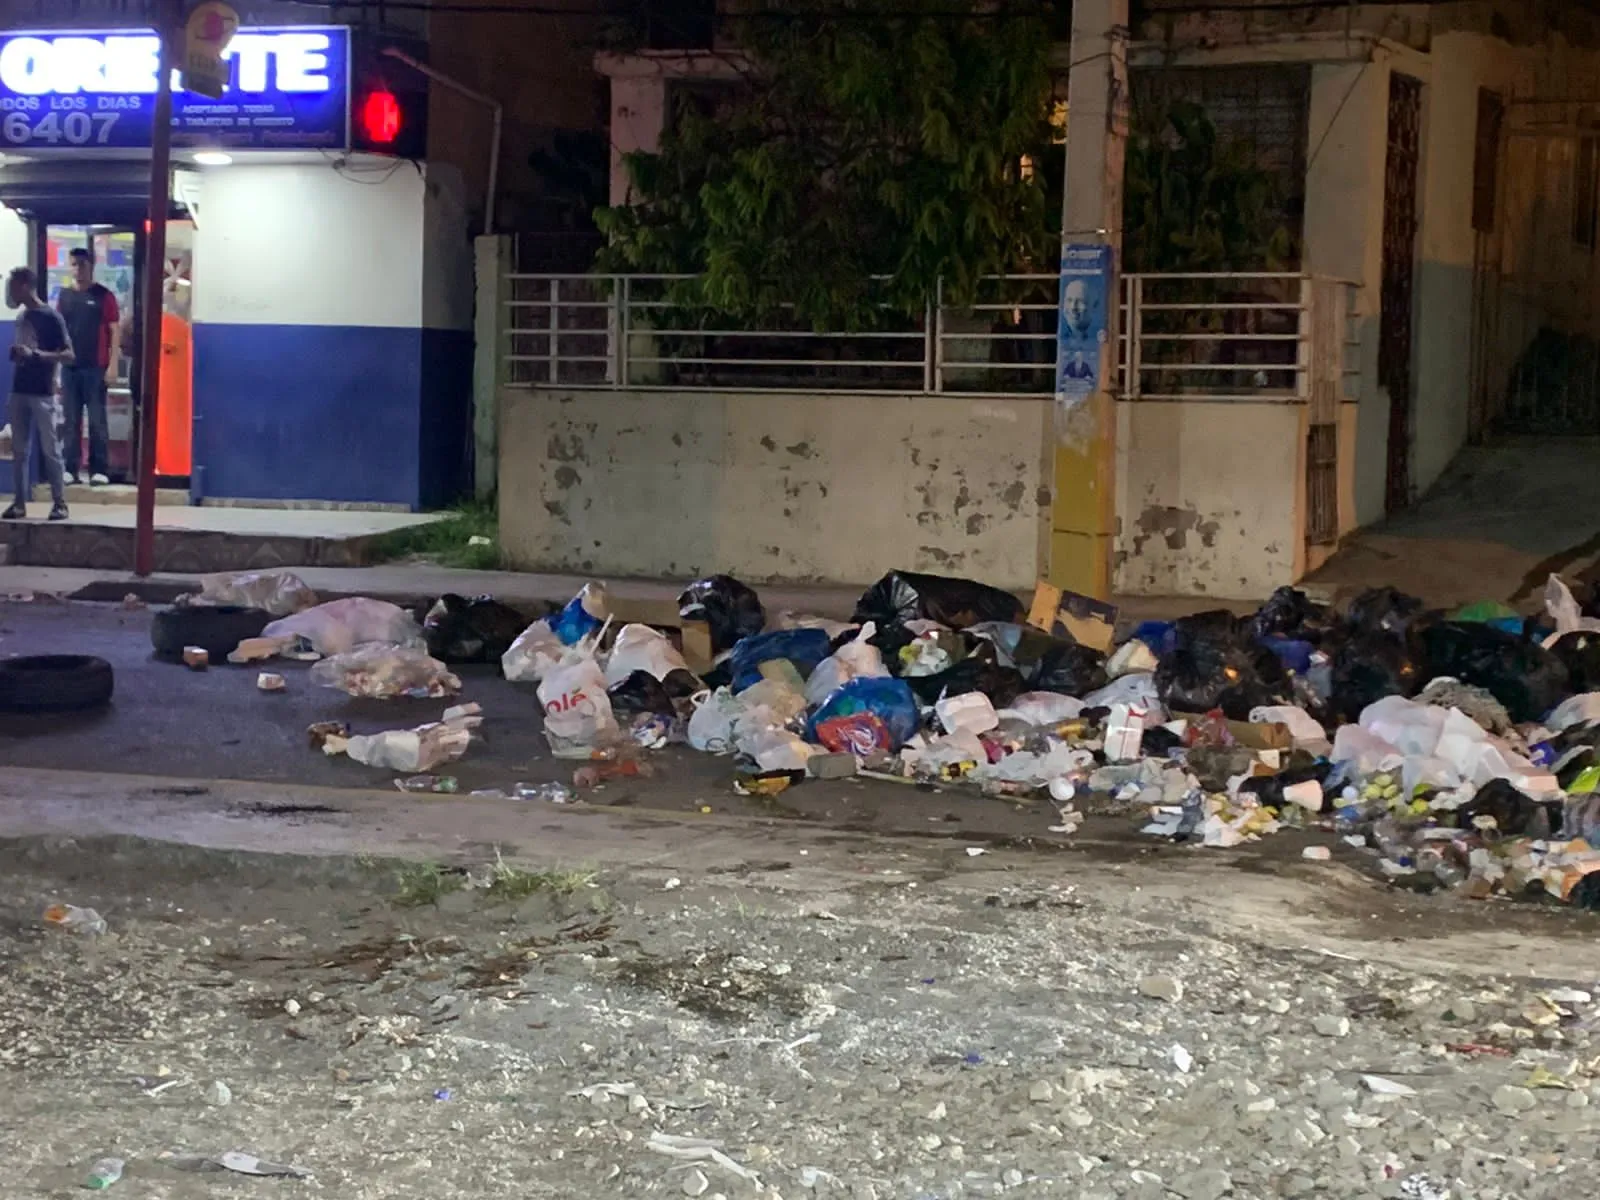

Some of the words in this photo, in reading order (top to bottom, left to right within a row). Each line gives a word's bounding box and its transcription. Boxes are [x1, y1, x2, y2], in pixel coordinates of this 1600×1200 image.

[0, 33, 329, 95] ORIETE
[0, 97, 40, 110] DOS
[51, 96, 87, 110] LOS
[97, 96, 141, 109] DIAS
[3, 112, 121, 144] 6407
